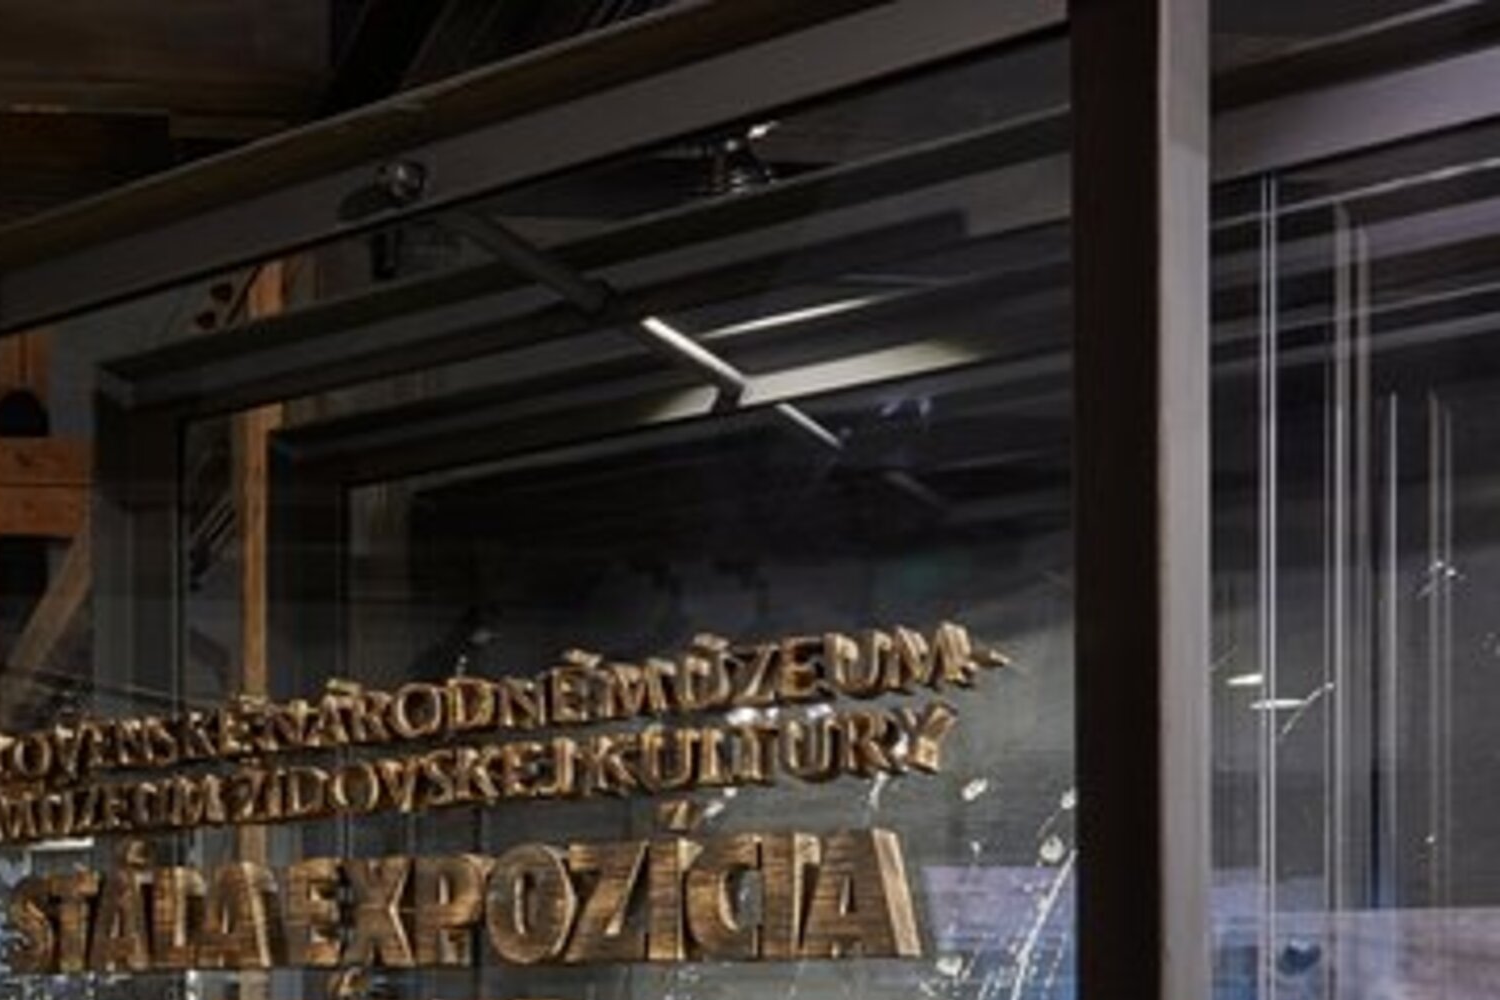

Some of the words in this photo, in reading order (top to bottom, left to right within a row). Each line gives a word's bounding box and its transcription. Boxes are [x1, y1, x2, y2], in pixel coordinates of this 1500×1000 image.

[258, 650, 602, 750] NÁRODNÉ
[230, 736, 578, 826] ŽIDOVSKEJ
[6, 840, 282, 972] STÁLA
[286, 802, 924, 968] EXPOZÍCIA
